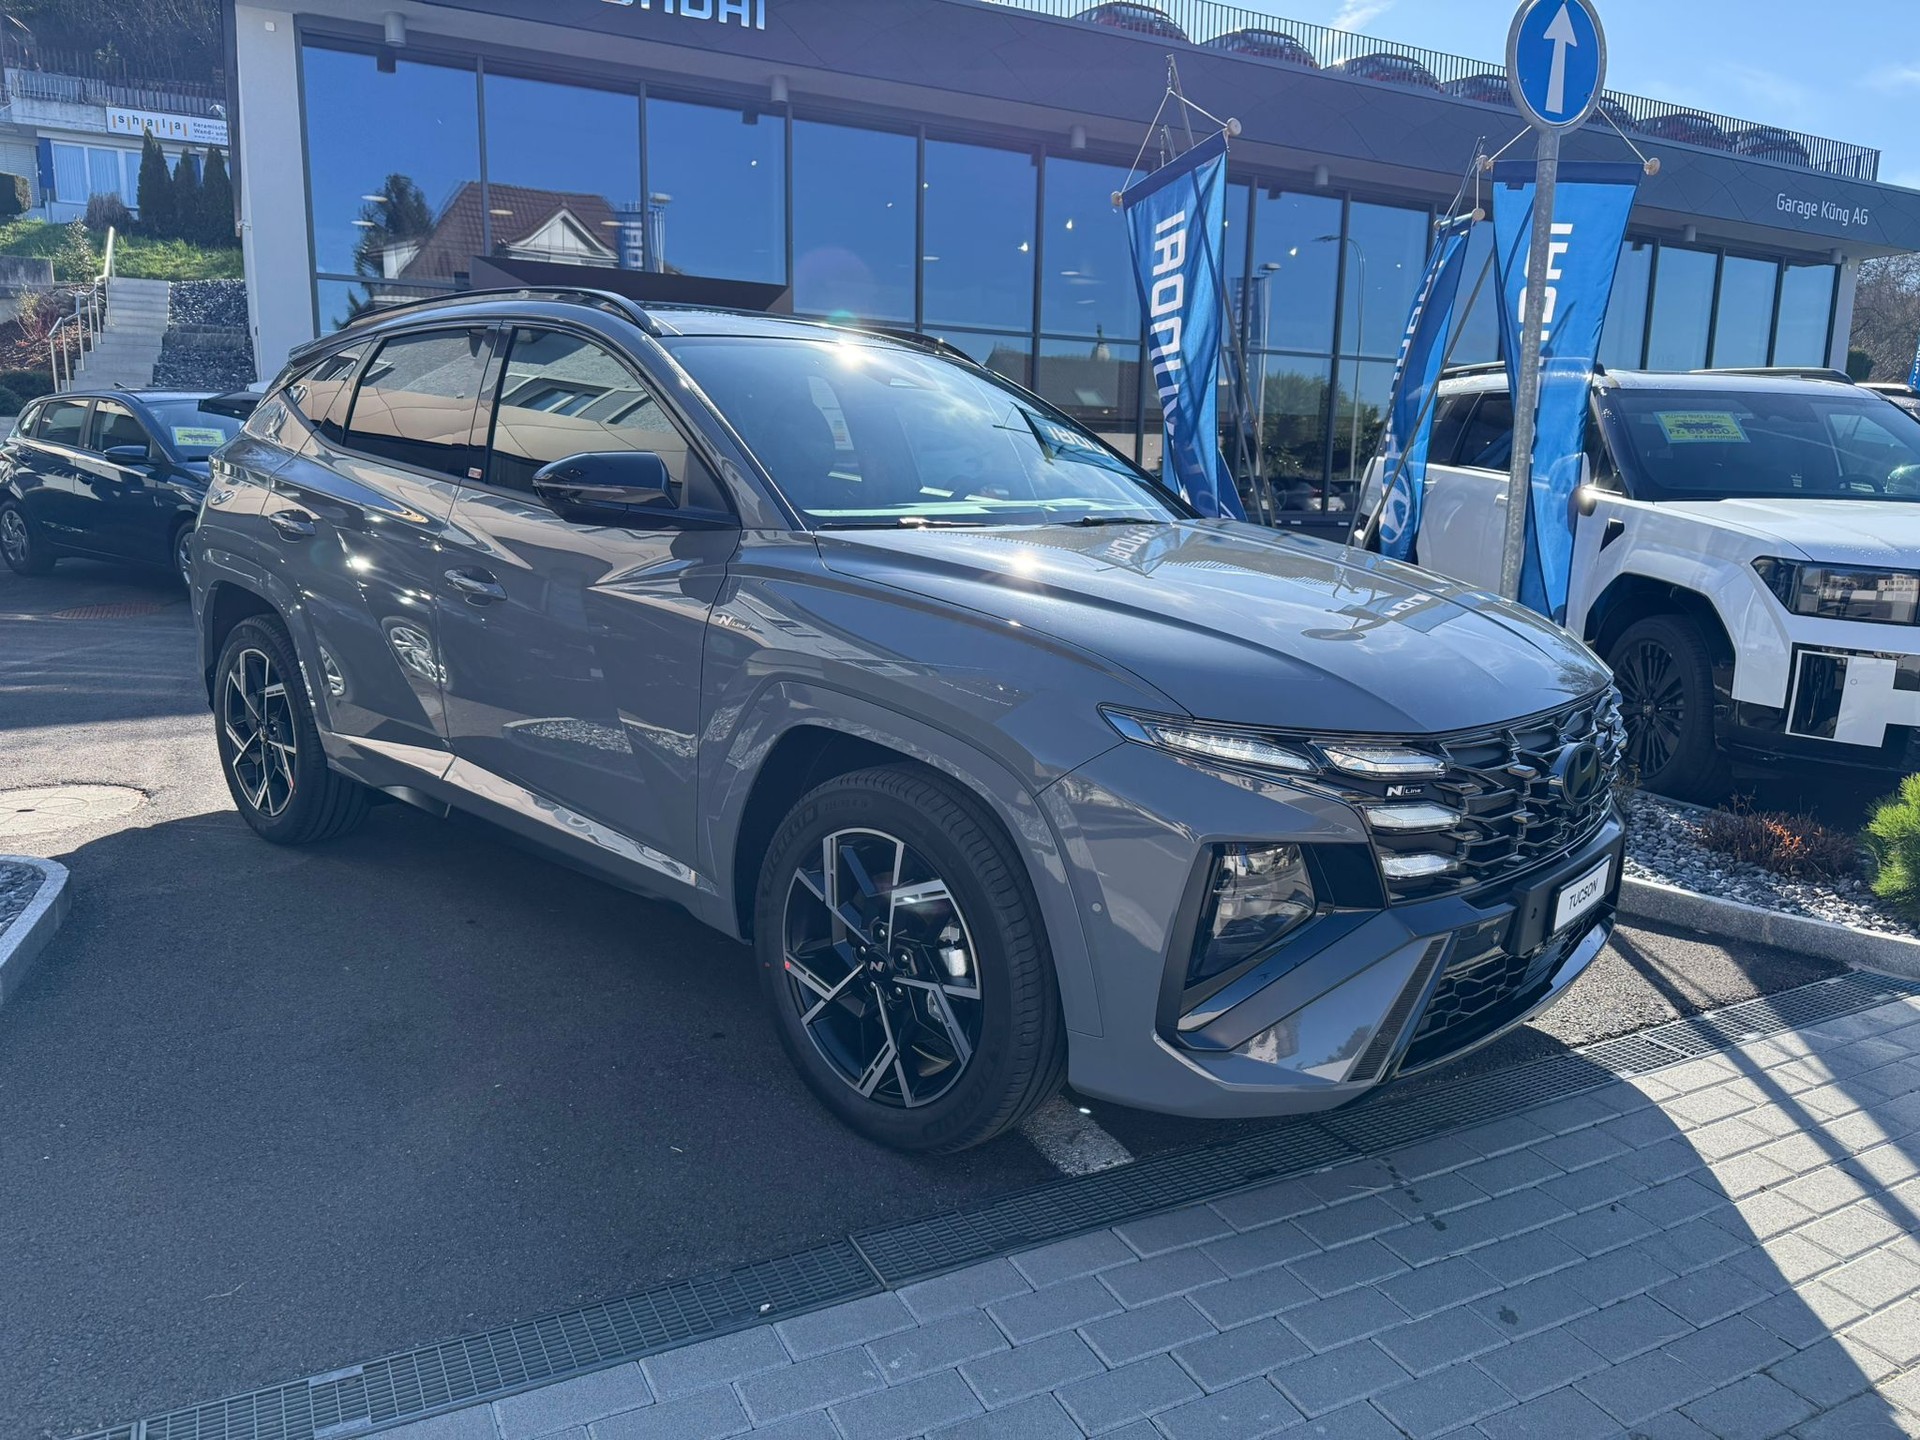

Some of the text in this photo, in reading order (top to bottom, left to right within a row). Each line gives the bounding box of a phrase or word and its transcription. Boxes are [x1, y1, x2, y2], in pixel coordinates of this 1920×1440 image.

[1776, 193, 1869, 226] Garage Küng AG
[718, 615, 733, 626] N
[1386, 785, 1404, 797] N
[1568, 878, 1599, 910] TUCSON
